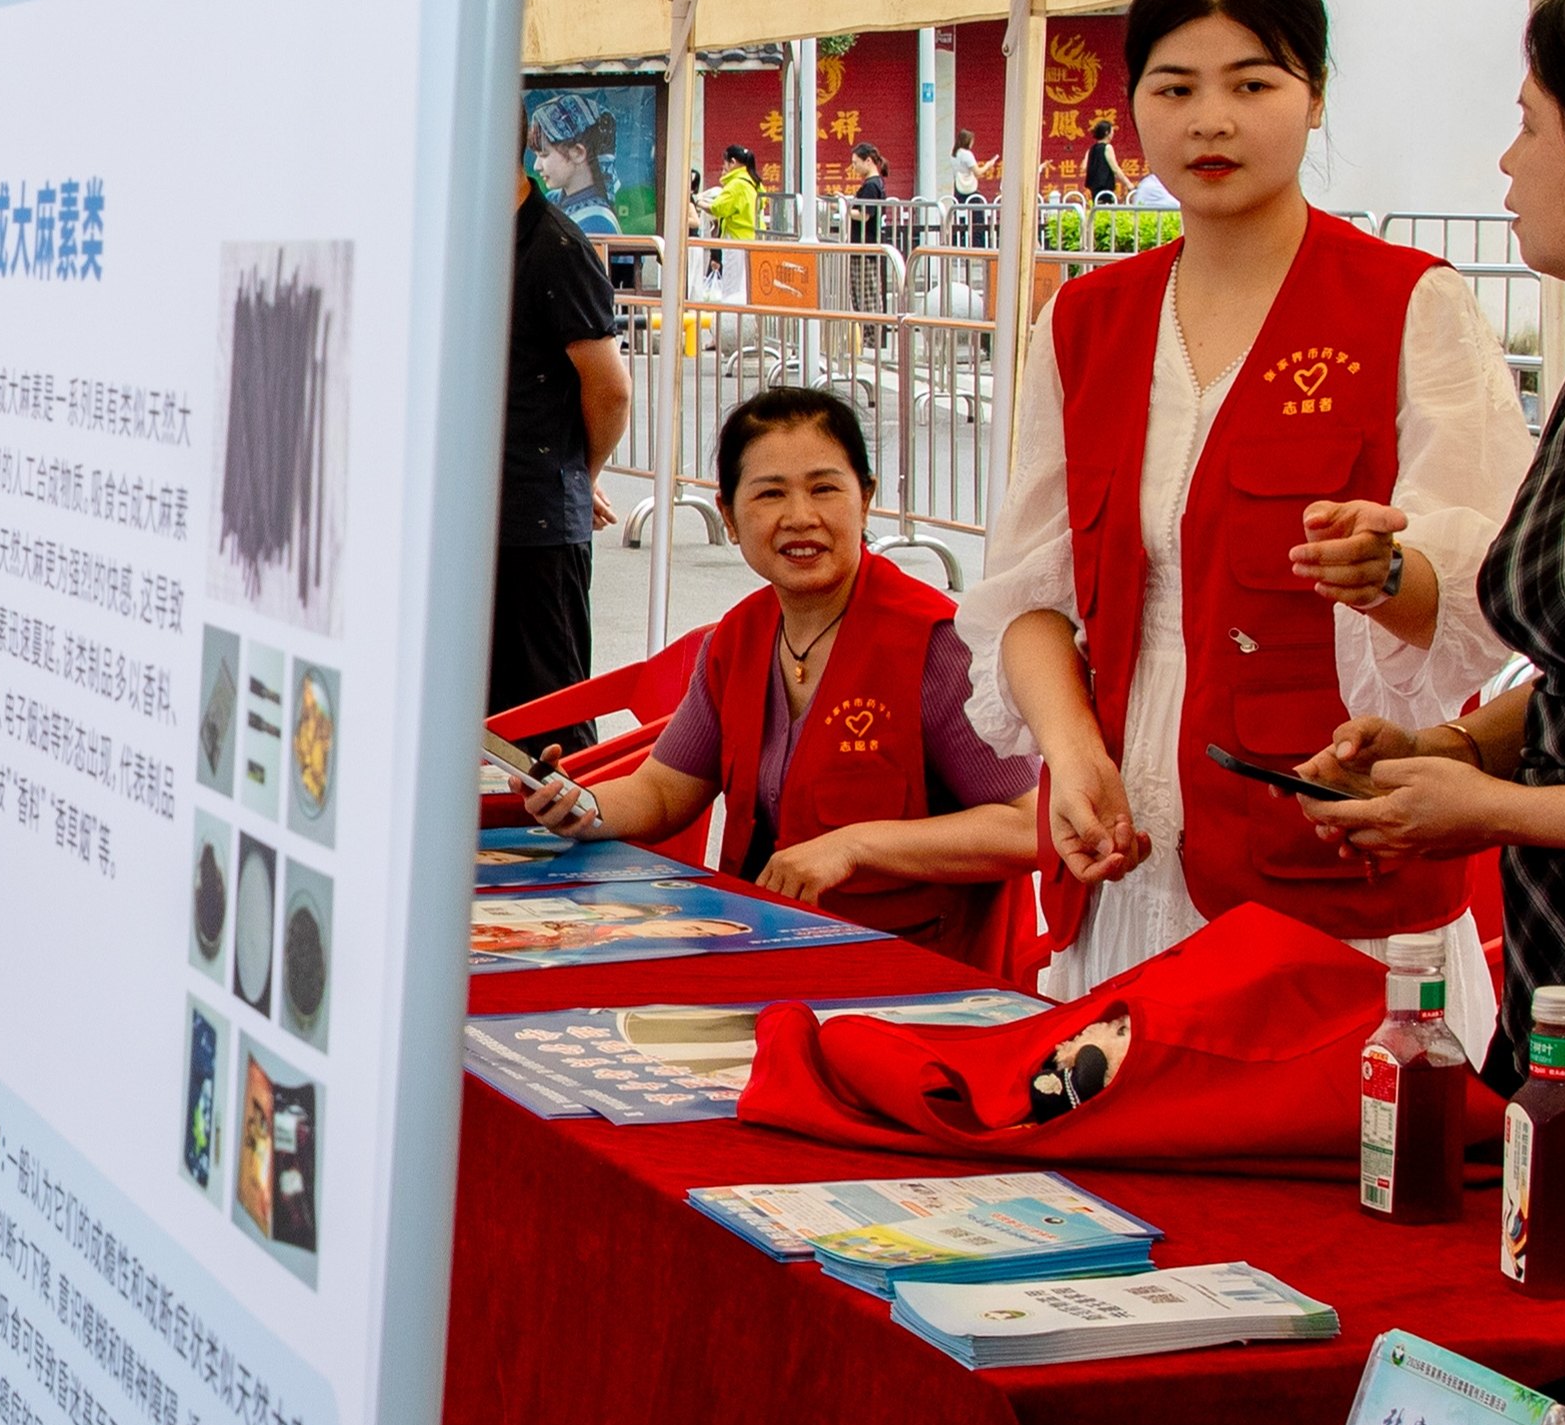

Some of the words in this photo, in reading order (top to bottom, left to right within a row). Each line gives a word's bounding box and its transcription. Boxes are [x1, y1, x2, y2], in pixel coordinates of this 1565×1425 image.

[760, 111, 862, 146] 老祥
[1282, 397, 1332, 415] 志愿者
[839, 739, 878, 752] 志愿者
